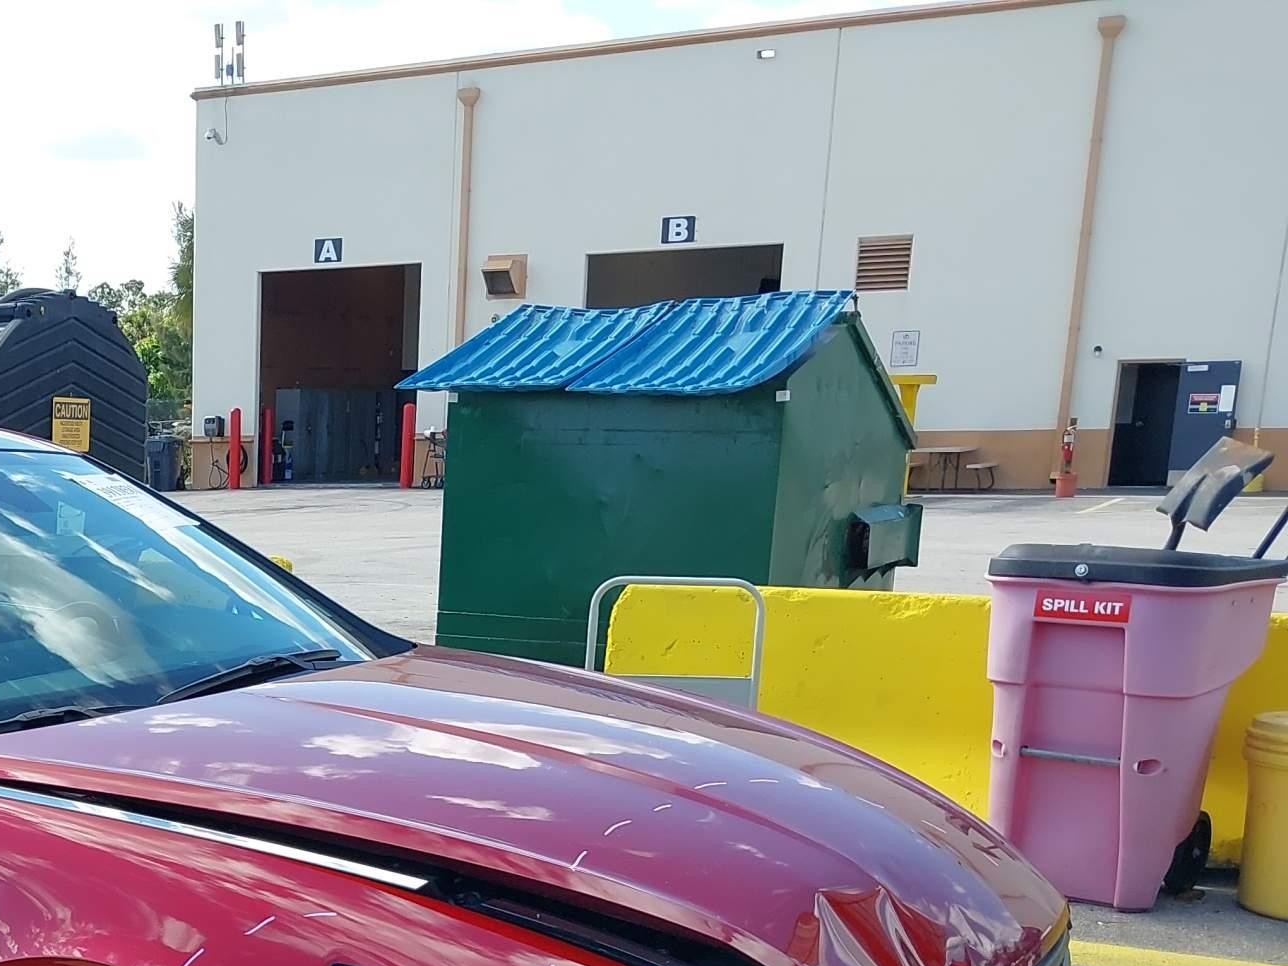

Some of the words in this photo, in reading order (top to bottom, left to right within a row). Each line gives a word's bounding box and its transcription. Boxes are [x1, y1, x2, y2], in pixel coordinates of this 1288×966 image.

[667, 218, 689, 242] B
[318, 239, 338, 262] A
[55, 403, 89, 419] CAUTION
[1041, 598, 1088, 613] SPILL
[1093, 601, 1124, 615] KIT
